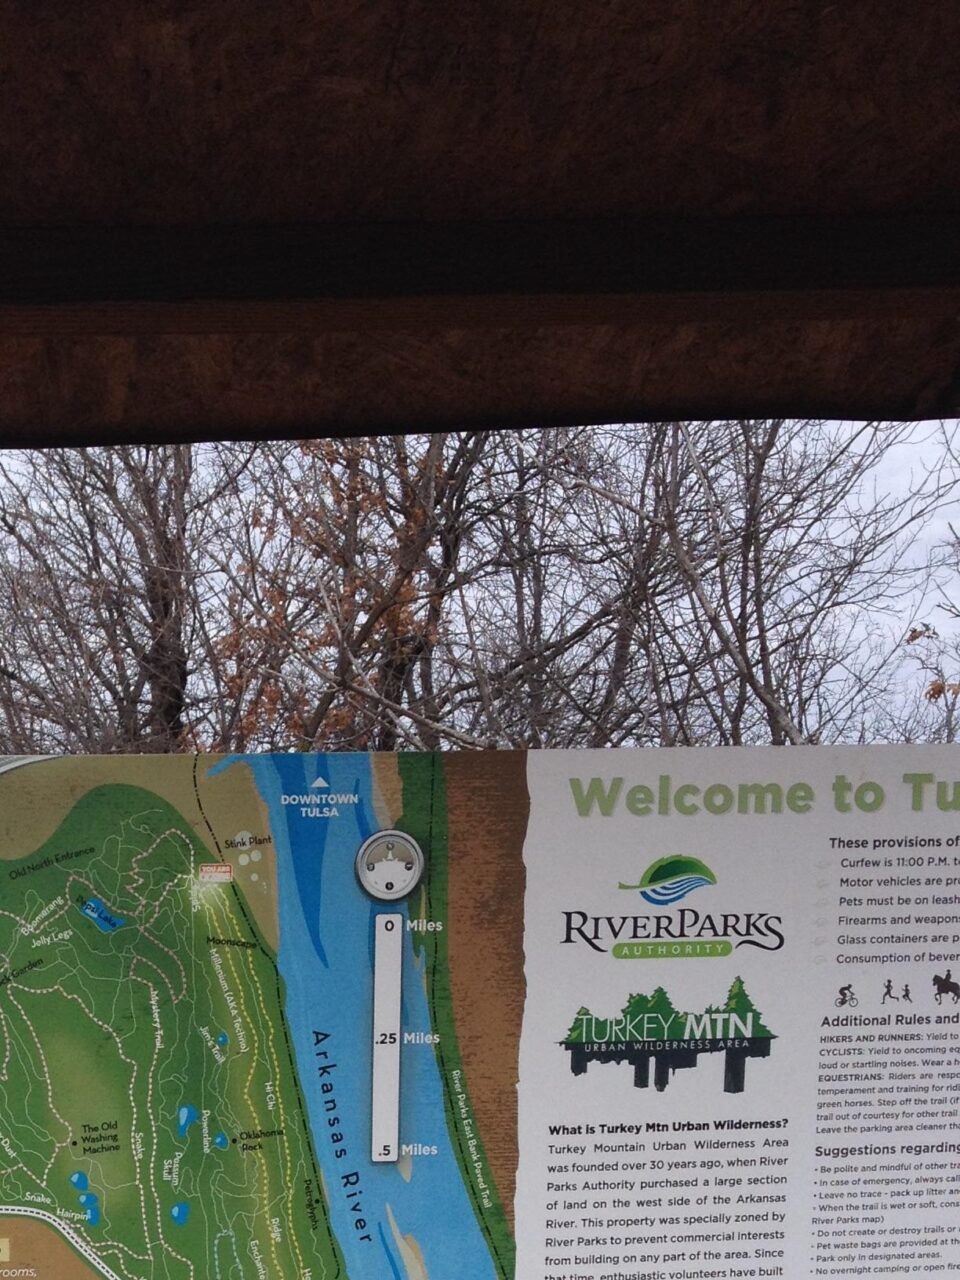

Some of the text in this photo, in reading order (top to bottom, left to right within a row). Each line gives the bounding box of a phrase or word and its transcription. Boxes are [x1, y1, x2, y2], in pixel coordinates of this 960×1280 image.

[280, 793, 359, 805] DOWNTOWN
[568, 774, 815, 817] Welcome
[831, 774, 886, 813] to
[300, 807, 339, 818] TULSA
[225, 834, 273, 849] Stink Plant
[829, 835, 960, 851] These provisions of
[28, 856, 54, 874] North
[55, 846, 96, 864] Entrance
[20, 895, 65, 937] Boomerang
[384, 919, 443, 932] 0 Miles
[621, 944, 725, 956] AUTHORITY
[820, 1012, 960, 1027] Additional Rules and
[578, 1012, 754, 1043] TURKEY MTN
[375, 1032, 440, 1045] .25 Miles
[584, 1039, 750, 1053] URBAN WILDERNESS AREA
[82, 1121, 119, 1133] The Old
[201, 1109, 211, 1154] Powerline
[548, 1118, 789, 1136] What is Turkey Mtn Urban Wilderness?
[81, 1133, 119, 1144] Washing
[239, 1129, 284, 1141] Oklahoma
[312, 1030, 372, 1243] Arkansas River
[82, 1144, 120, 1155] Machine
[378, 1143, 438, 1157] .5 Miles
[815, 1141, 960, 1159] Suggestions regarding
